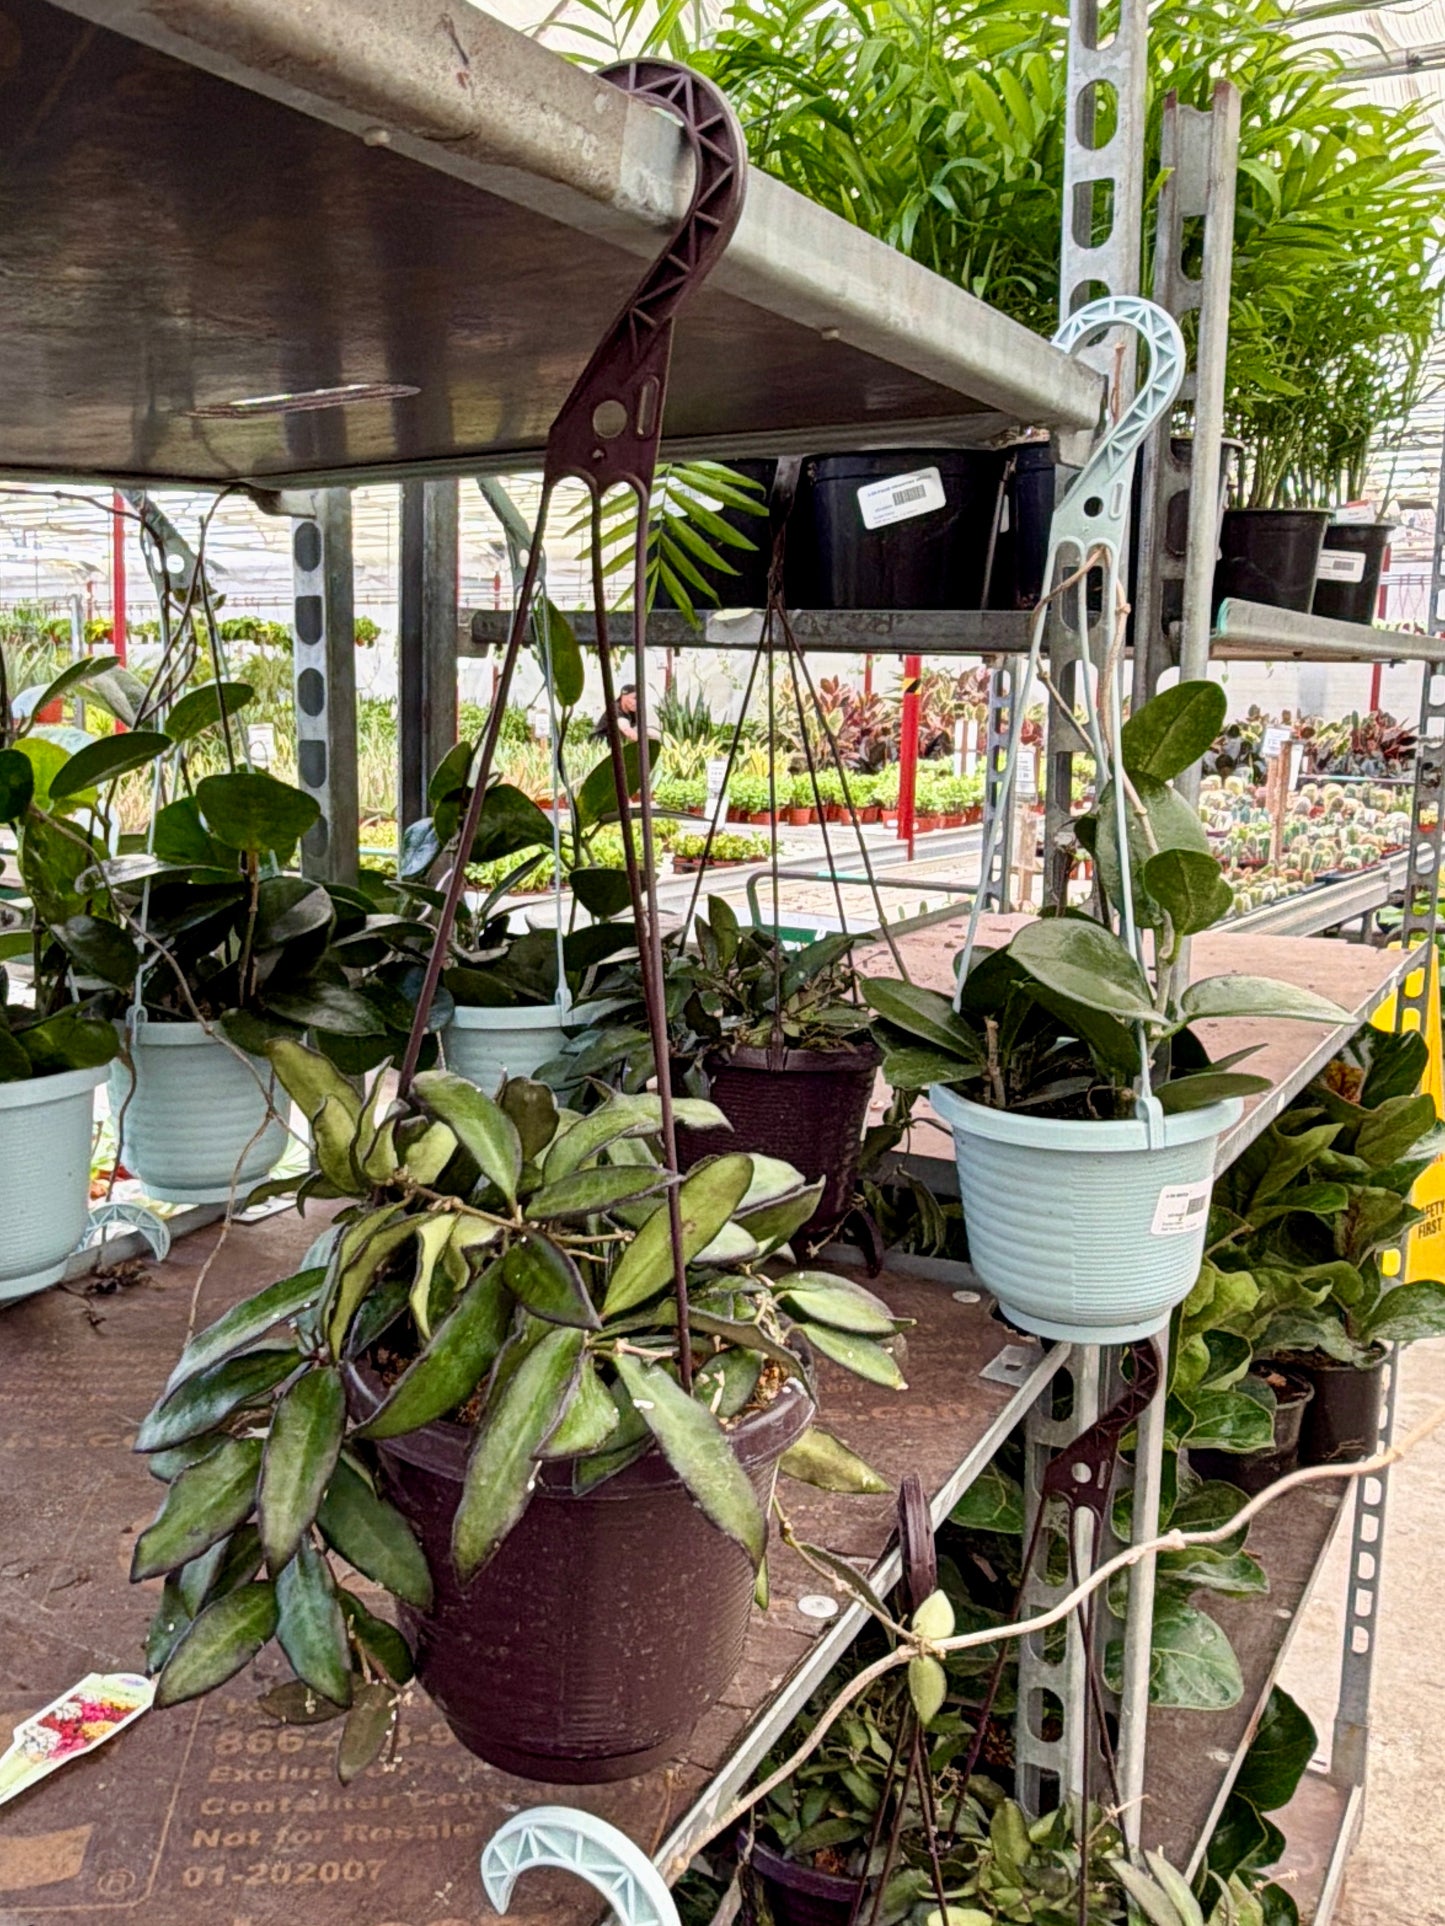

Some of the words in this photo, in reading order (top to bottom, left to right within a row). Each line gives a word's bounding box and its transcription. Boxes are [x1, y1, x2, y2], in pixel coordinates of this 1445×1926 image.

[1418, 1217, 1442, 1239] FIRST
[208, 1762, 391, 1783] Exclus
[201, 1793, 394, 1816] Container
[191, 1827, 262, 1849] Not
[274, 1826, 330, 1847] for
[342, 1817, 475, 1844] Resale
[182, 1857, 388, 1888] 01-202007
